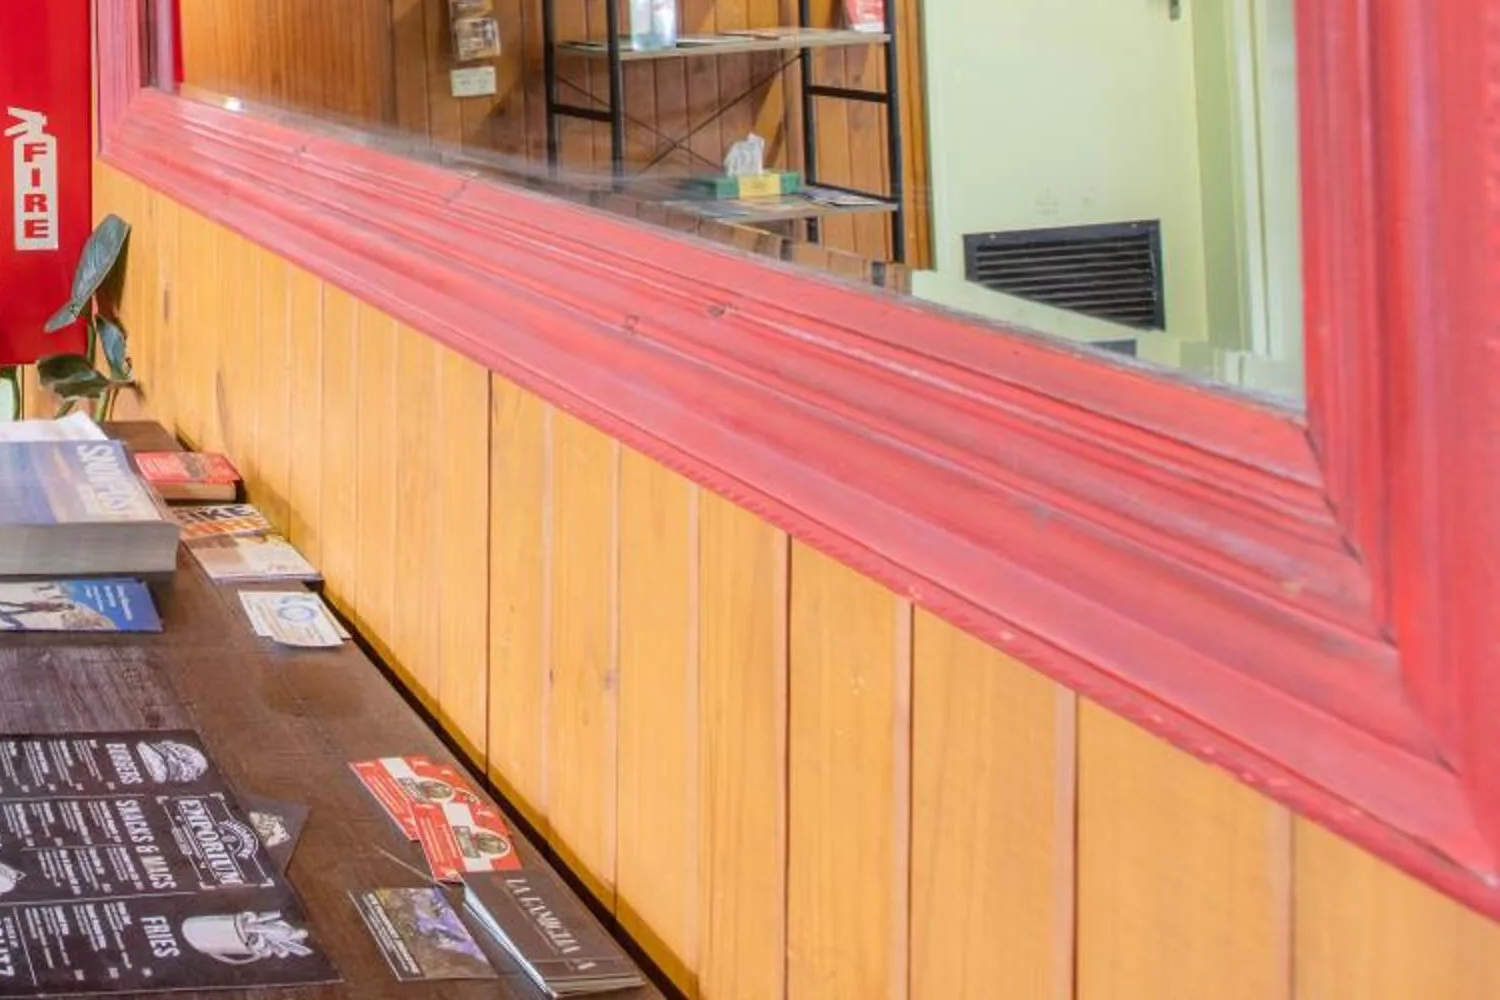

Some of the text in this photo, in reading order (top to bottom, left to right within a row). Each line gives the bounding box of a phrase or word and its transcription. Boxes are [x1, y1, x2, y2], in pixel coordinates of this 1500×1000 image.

[23, 143, 49, 239] FIRE
[115, 799, 155, 843] SNACKS
[140, 915, 181, 958] FRIES
